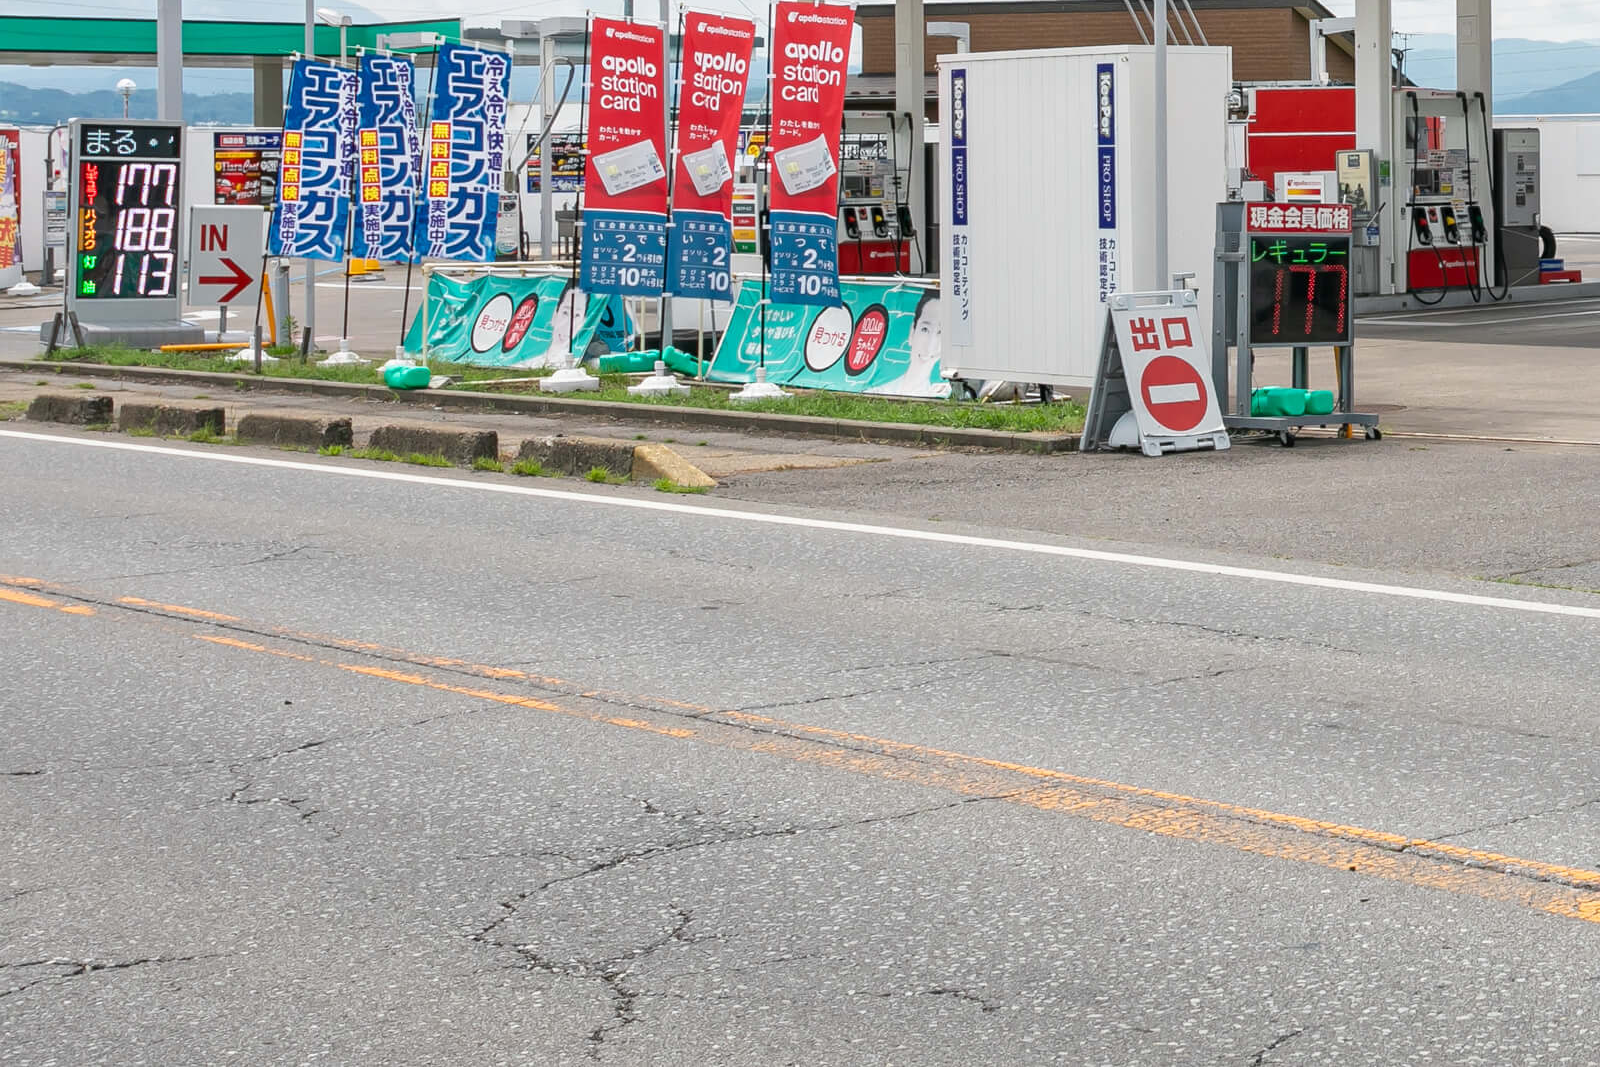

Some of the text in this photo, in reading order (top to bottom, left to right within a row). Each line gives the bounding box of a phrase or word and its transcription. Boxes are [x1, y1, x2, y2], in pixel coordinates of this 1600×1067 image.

[799, 14, 848, 26] apollostation
[601, 55, 657, 77] apollo
[694, 51, 747, 74] apollo
[785, 40, 844, 63] apollo
[601, 75, 657, 98] station
[693, 72, 743, 95] sation
[783, 64, 841, 86] station
[599, 94, 641, 112] card
[691, 91, 721, 112] crd
[781, 85, 819, 103] card
[953, 77, 964, 139] KeePer
[1099, 72, 1112, 138] KeePer
[339, 74, 360, 195] 冷え冷え快適!
[485, 56, 505, 191] 冷え冷え快適!!
[86, 129, 137, 155] まる
[445, 51, 487, 258] エアコンガス
[283, 132, 301, 201] 無料点検
[294, 67, 341, 256] エアコンガス
[361, 131, 381, 202] 無料点検
[371, 60, 414, 257] エアコンガス
[431, 122, 450, 197] 無料点検
[84, 162, 177, 206] レギュラー 177
[956, 155, 964, 220] PRO SHOP
[1103, 155, 1112, 223] PRO SHOP
[83, 208, 176, 252] ハイオク 188
[280, 203, 297, 255] 実施中!!
[364, 204, 382, 259] 実施中!!
[429, 200, 447, 257] 実施中!!
[1250, 206, 1350, 230] 現金会員価格
[200, 224, 228, 252] IN
[592, 232, 666, 246] いつでも
[622, 243, 637, 263] 2
[682, 234, 716, 246] いつ
[1251, 239, 1347, 265] レギュラー
[712, 246, 727, 266] 2
[802, 248, 818, 269] 2
[953, 234, 961, 296] 技術認定店
[1099, 237, 1108, 304] 技術認定店
[82, 252, 174, 297] 灯油 113
[617, 267, 641, 287] 10
[707, 271, 729, 292] 10
[797, 274, 821, 296] 10
[961, 234, 970, 321] カーコーティング
[1271, 264, 1348, 335] 177
[811, 325, 848, 348] 見つかる
[1129, 317, 1193, 352] 出口
